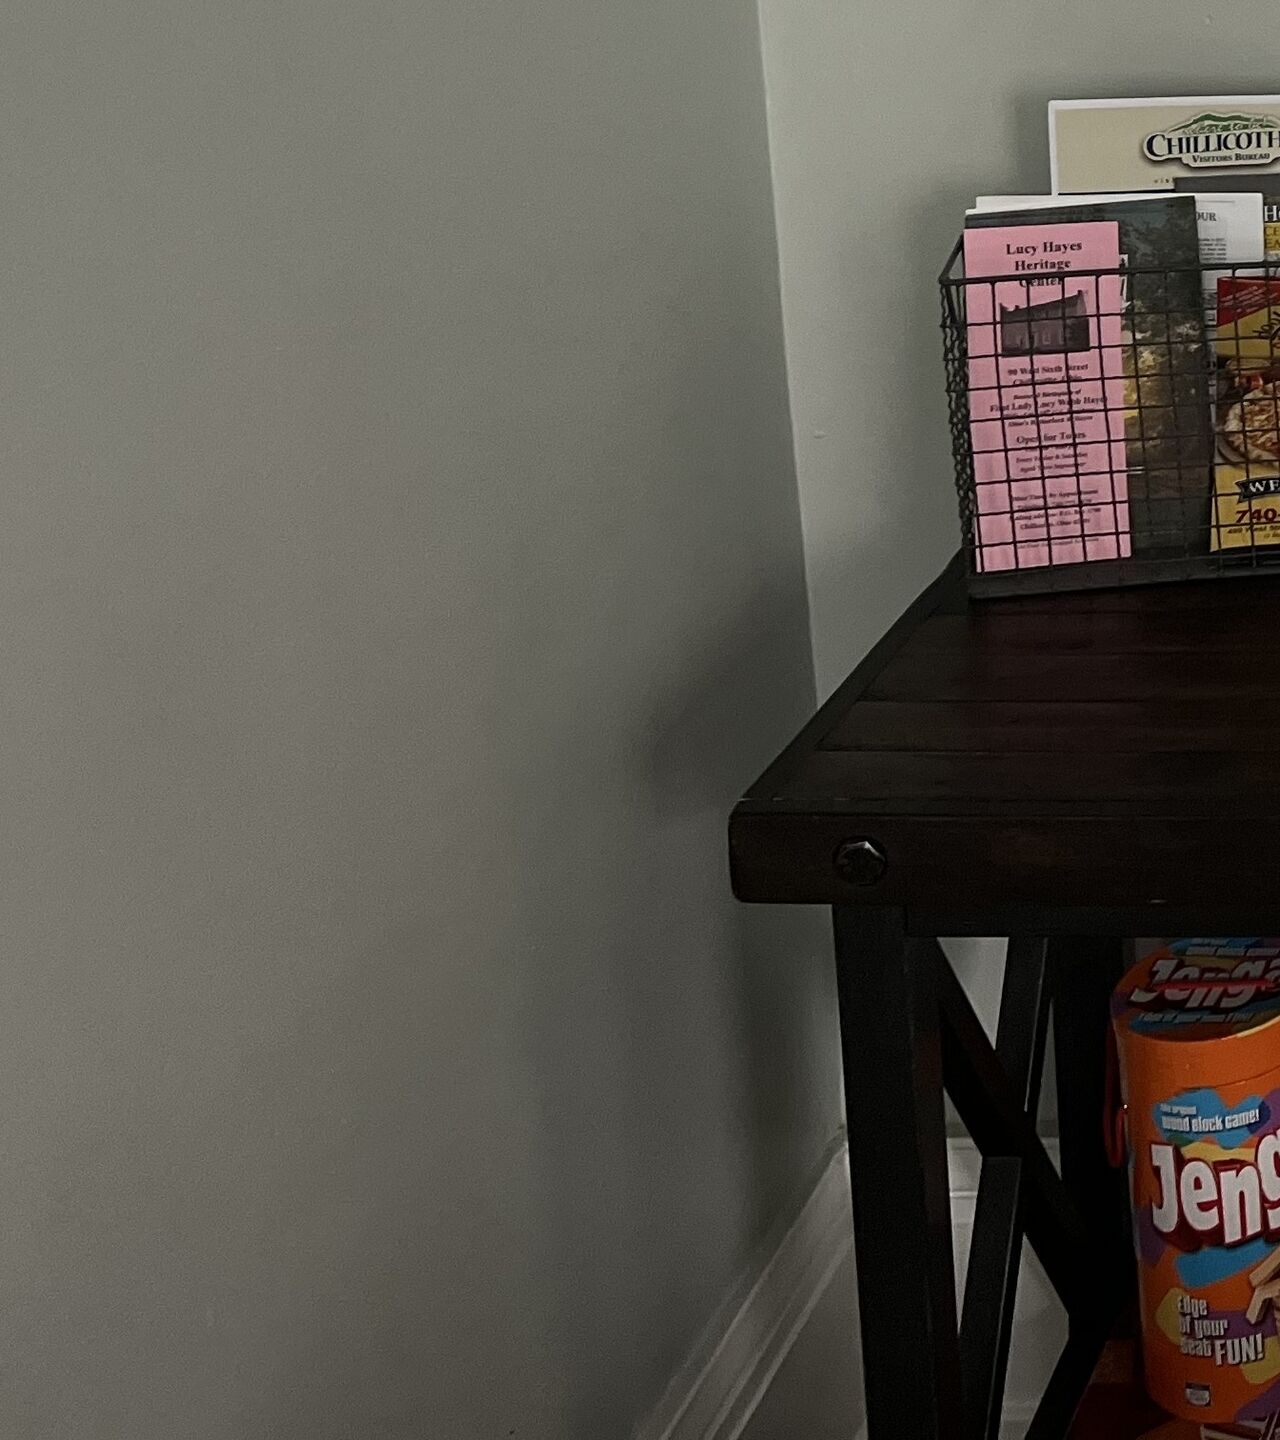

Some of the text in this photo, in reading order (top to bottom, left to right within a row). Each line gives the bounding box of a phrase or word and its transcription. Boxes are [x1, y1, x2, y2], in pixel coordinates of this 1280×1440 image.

[1192, 154, 1233, 164] VISITORS
[1006, 241, 1083, 256] Lucy Hayes
[1015, 259, 1072, 272] Heritage
[1249, 479, 1280, 494] WE
[1194, 1317, 1228, 1339] your
[1214, 1332, 1265, 1366] FUN!
